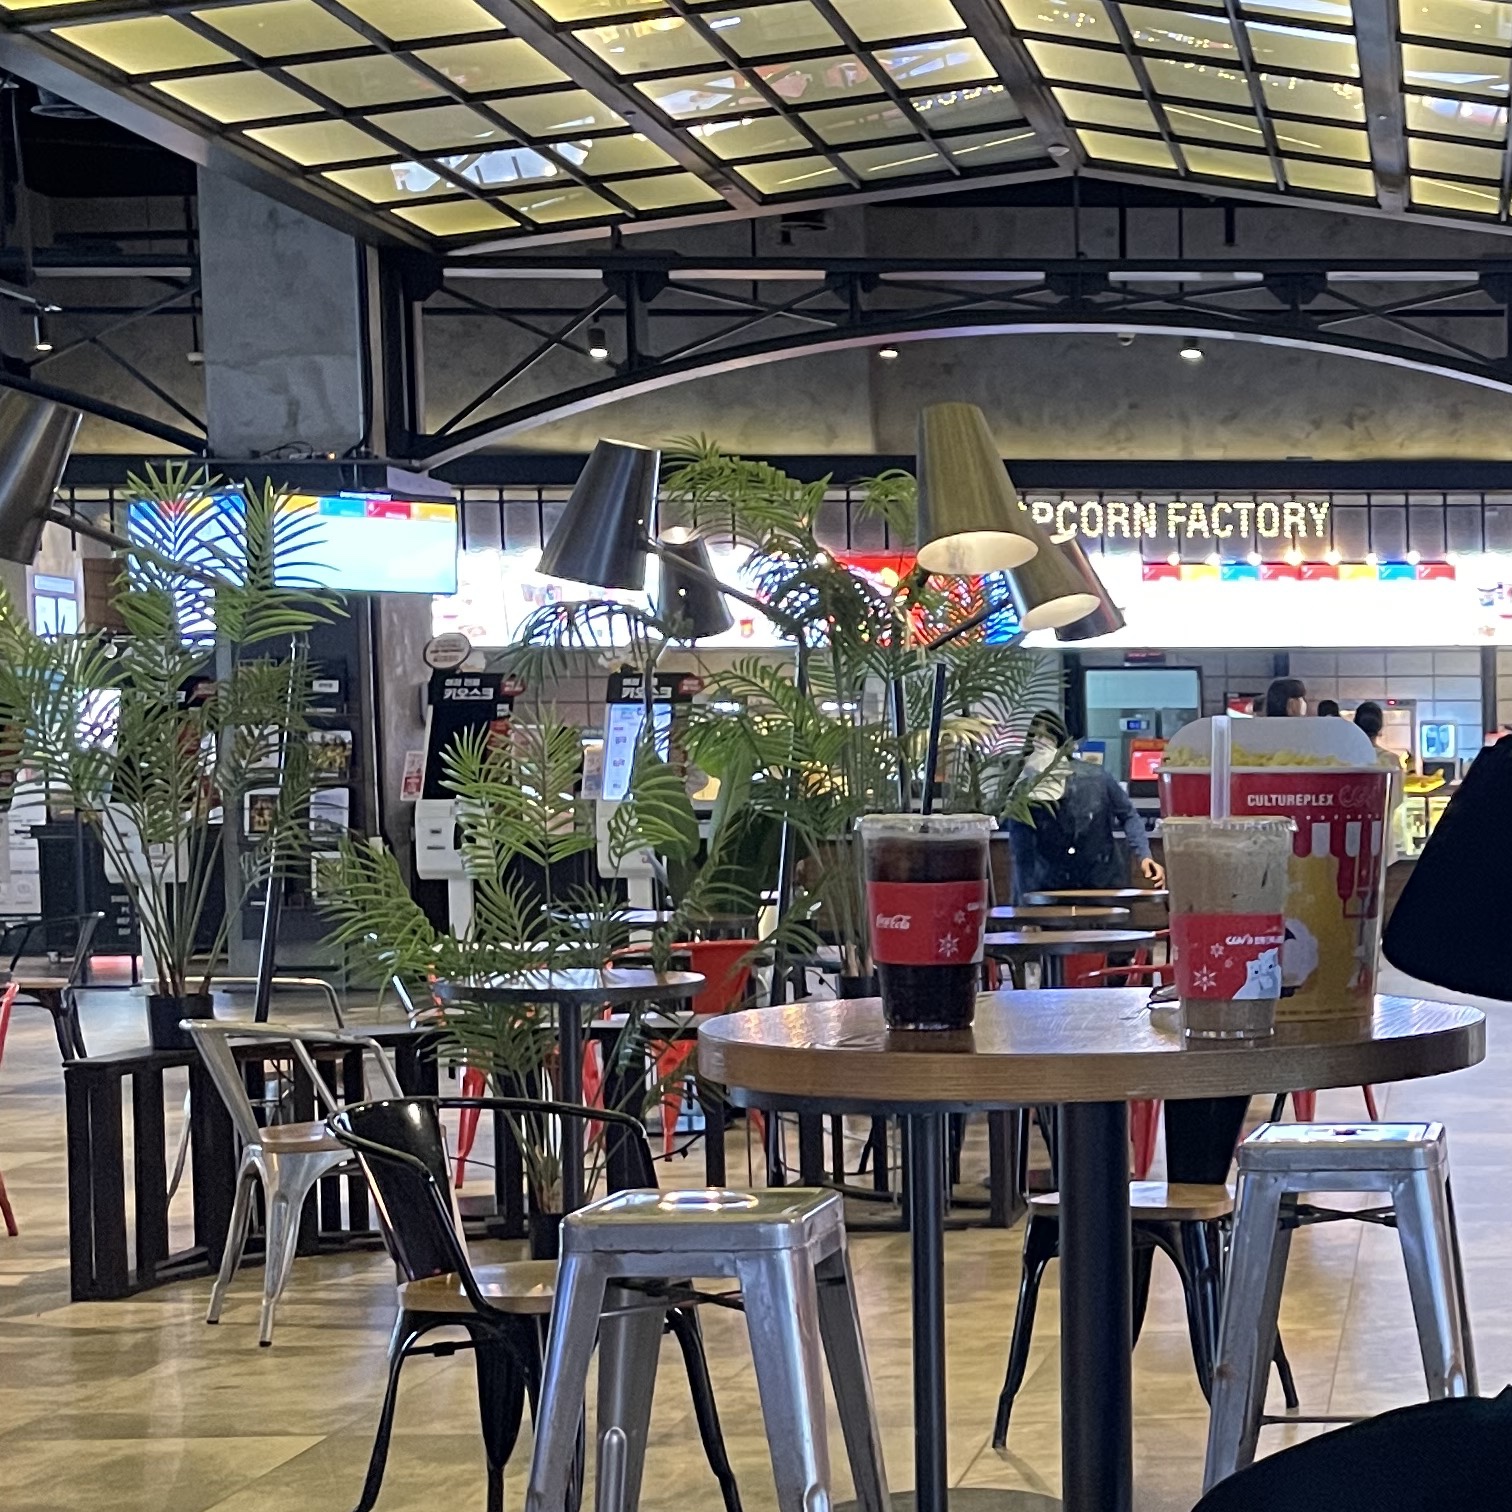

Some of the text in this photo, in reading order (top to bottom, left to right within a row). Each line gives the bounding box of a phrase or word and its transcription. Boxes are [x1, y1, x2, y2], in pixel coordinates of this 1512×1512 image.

[1018, 501, 1330, 538] PCORN FACTORY
[443, 687, 495, 700] 키오스크
[1247, 793, 1334, 807] CULTUREPLEX
